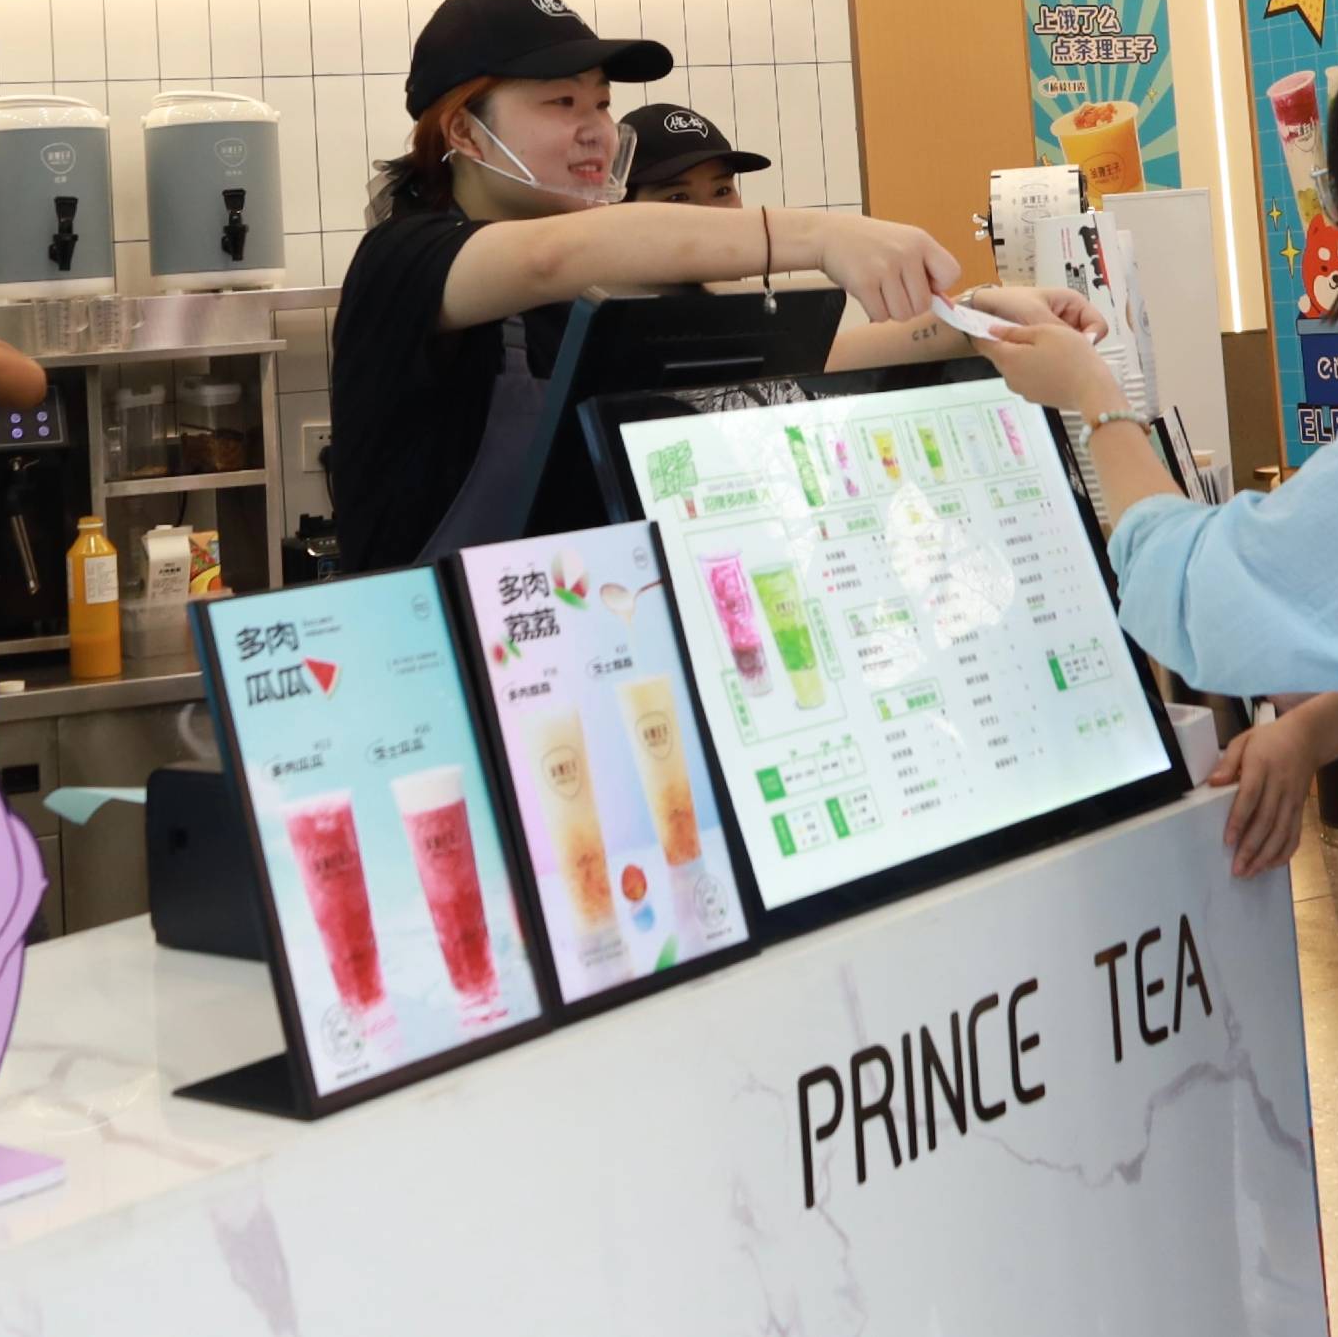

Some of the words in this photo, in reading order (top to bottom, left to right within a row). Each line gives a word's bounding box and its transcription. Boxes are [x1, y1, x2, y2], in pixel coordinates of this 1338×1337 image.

[1035, 5, 1121, 34] 上饿了么
[1053, 37, 1158, 63] 点茶理王子
[497, 569, 551, 605] 多肉
[235, 621, 299, 662] 多肉
[245, 663, 312, 708] 瓜瓜
[798, 977, 1045, 1210] PRINCE
[1094, 913, 1212, 1062] TEA
